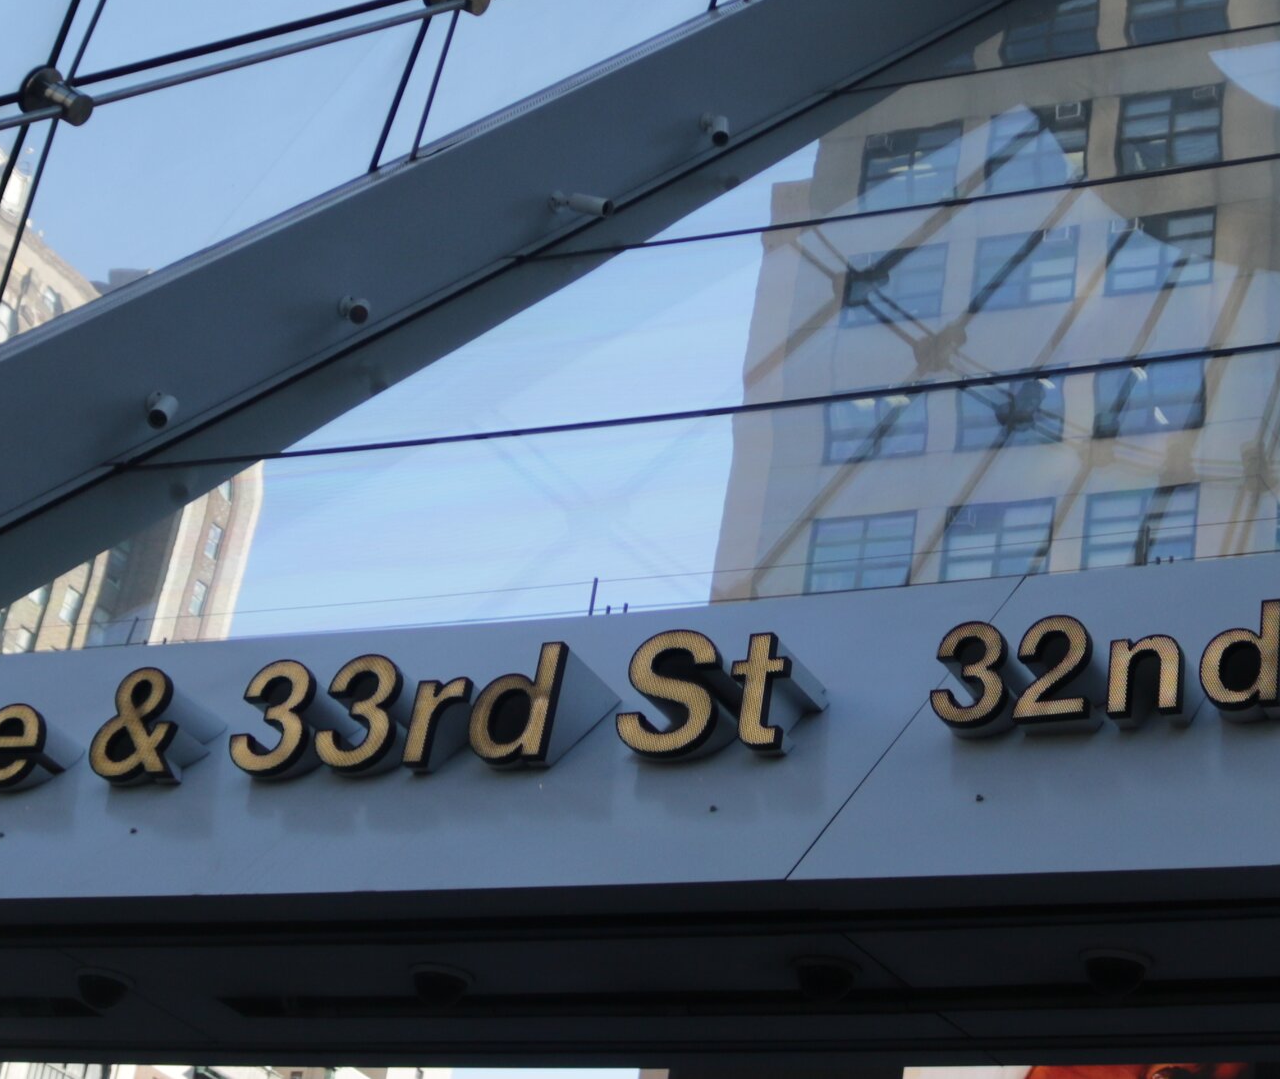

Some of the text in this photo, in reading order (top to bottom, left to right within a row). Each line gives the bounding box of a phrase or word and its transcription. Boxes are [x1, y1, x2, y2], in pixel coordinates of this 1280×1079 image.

[88, 666, 178, 787] &
[228, 641, 570, 780] 33rd
[615, 628, 790, 763] St
